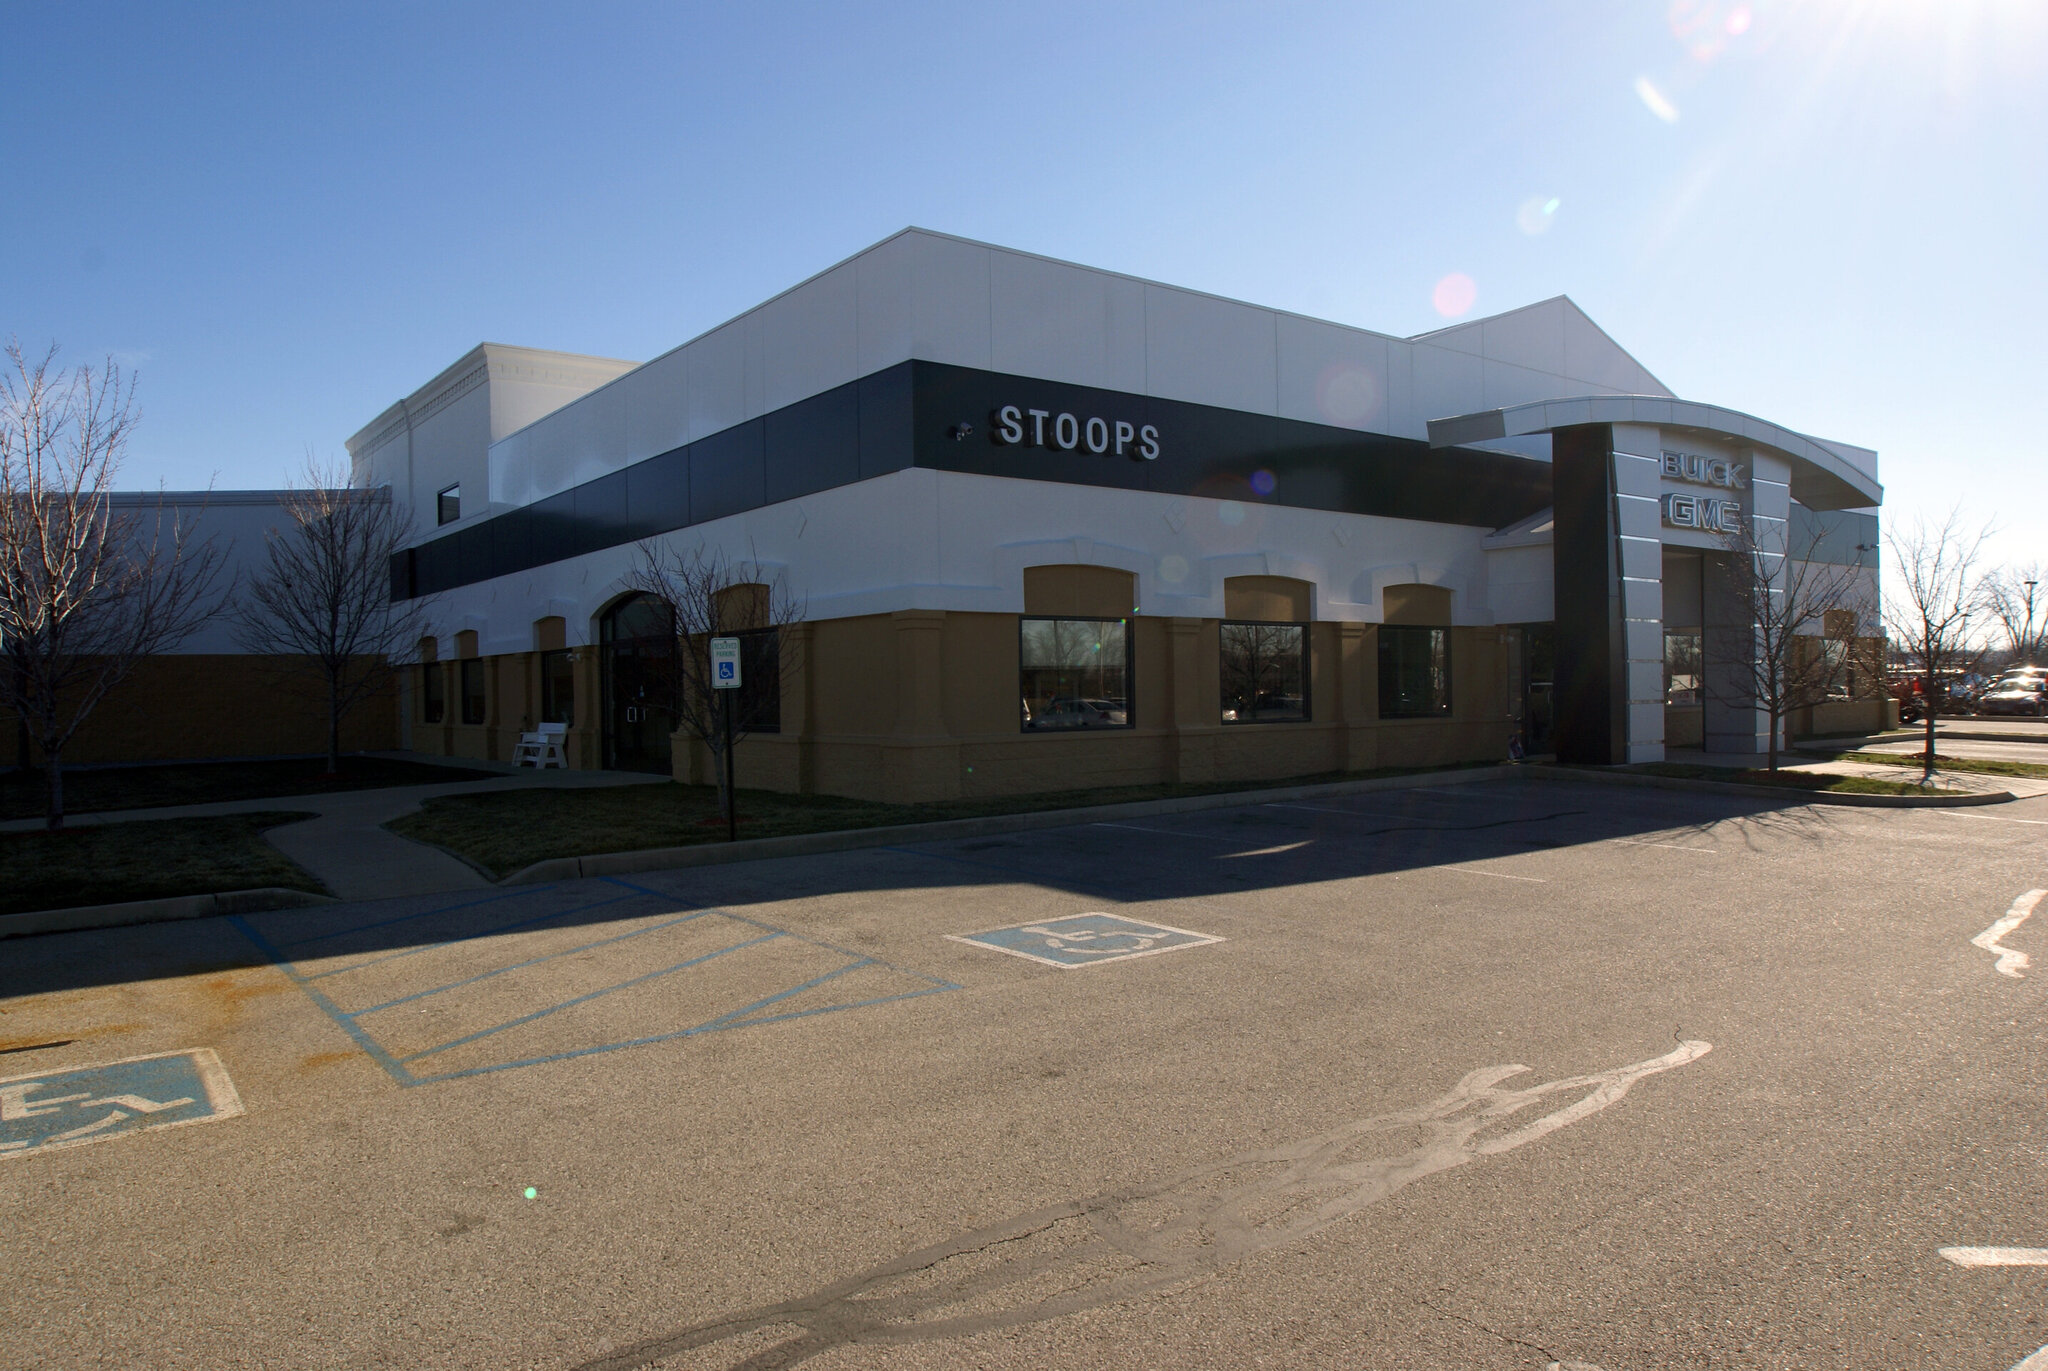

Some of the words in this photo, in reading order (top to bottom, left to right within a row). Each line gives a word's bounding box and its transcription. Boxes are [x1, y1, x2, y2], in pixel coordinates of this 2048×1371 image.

[1000, 405, 1160, 461] STOOPS
[1661, 450, 1745, 489] BUICK
[1668, 493, 1741, 534] GMC
